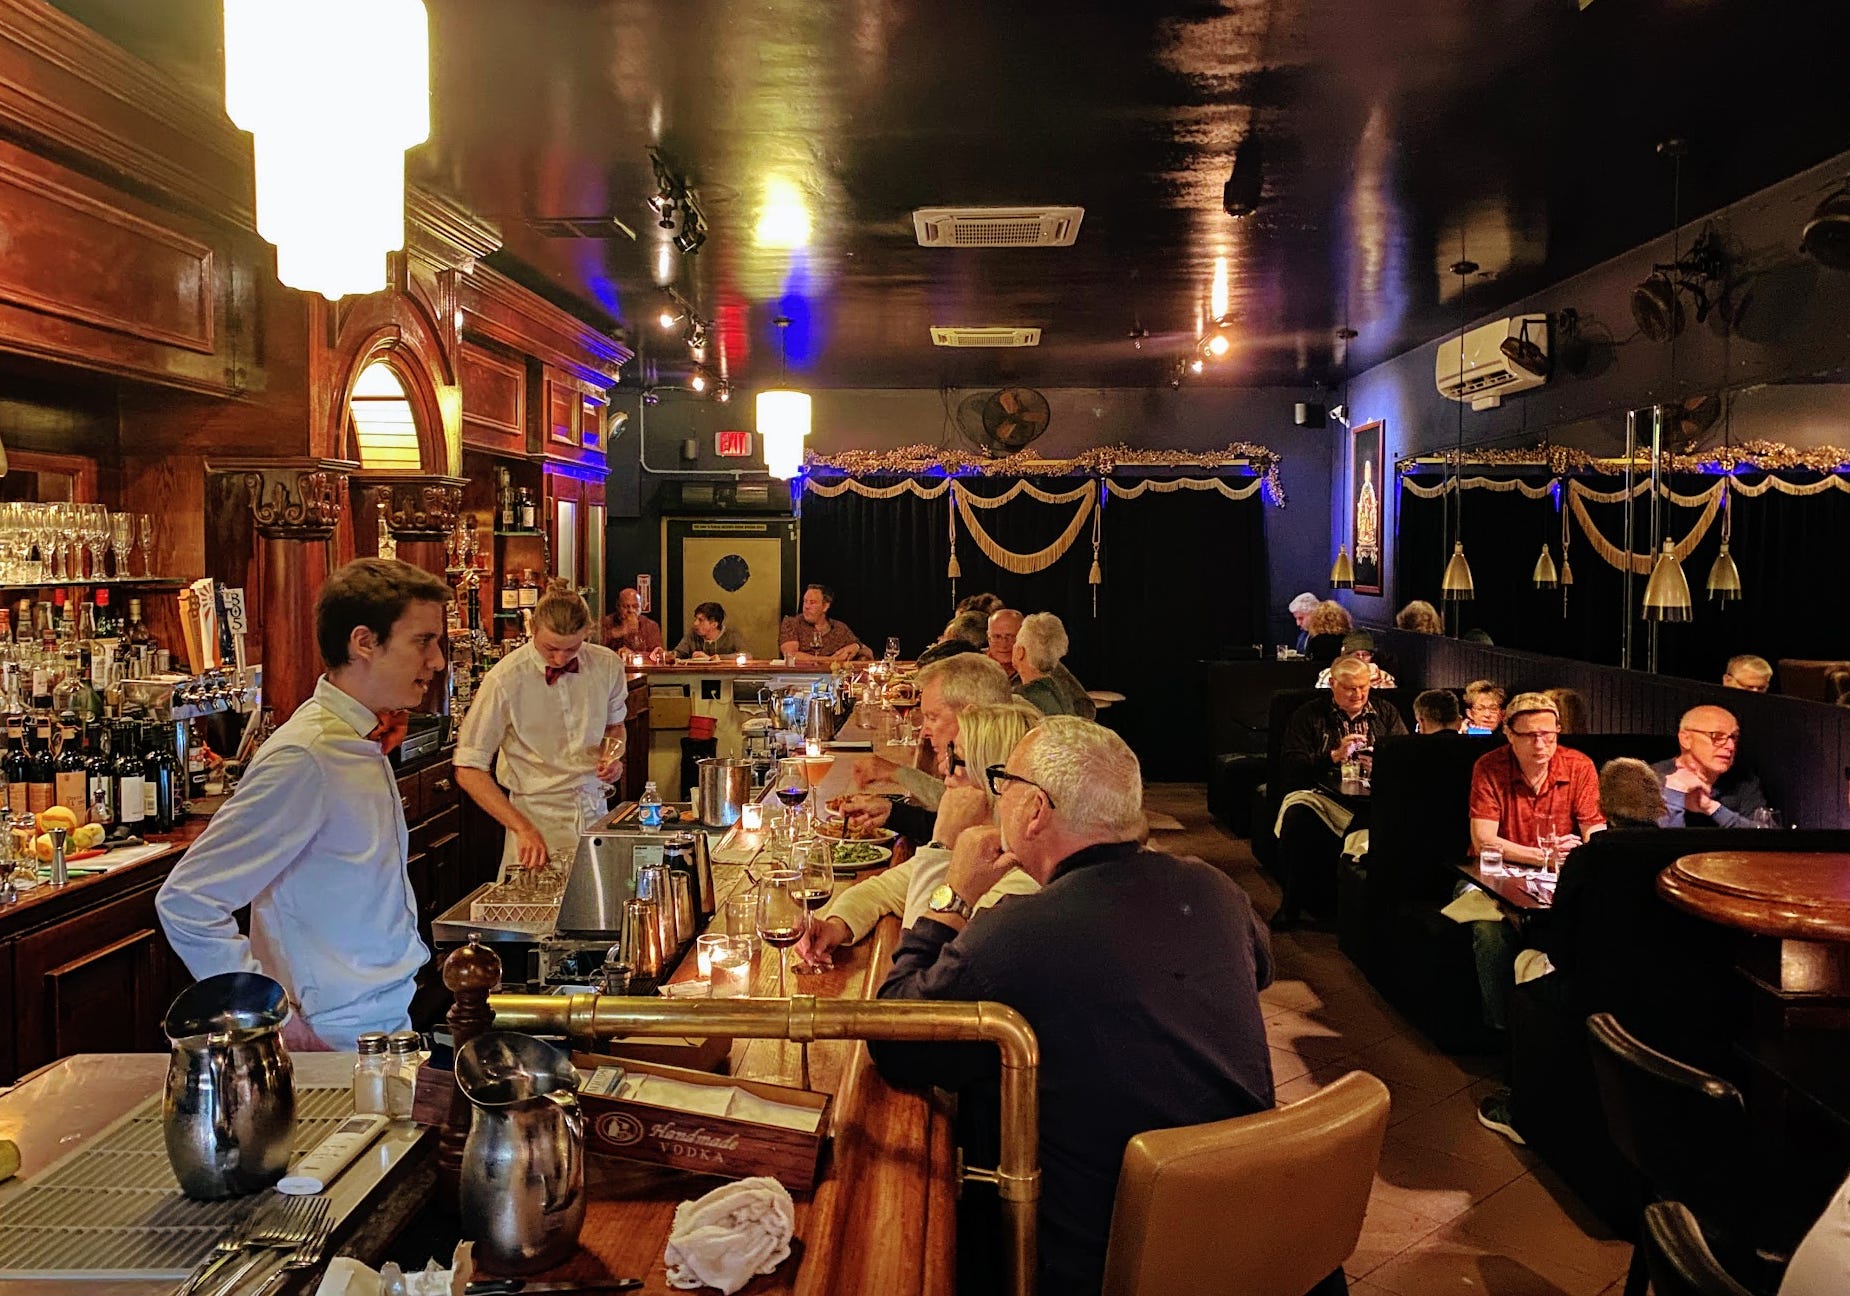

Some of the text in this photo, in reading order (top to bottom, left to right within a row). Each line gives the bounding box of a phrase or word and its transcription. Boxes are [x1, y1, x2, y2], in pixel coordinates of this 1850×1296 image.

[720, 432, 746, 454] EXIT
[648, 1122, 740, 1151] Handmade
[658, 1141, 724, 1163] VODKA
